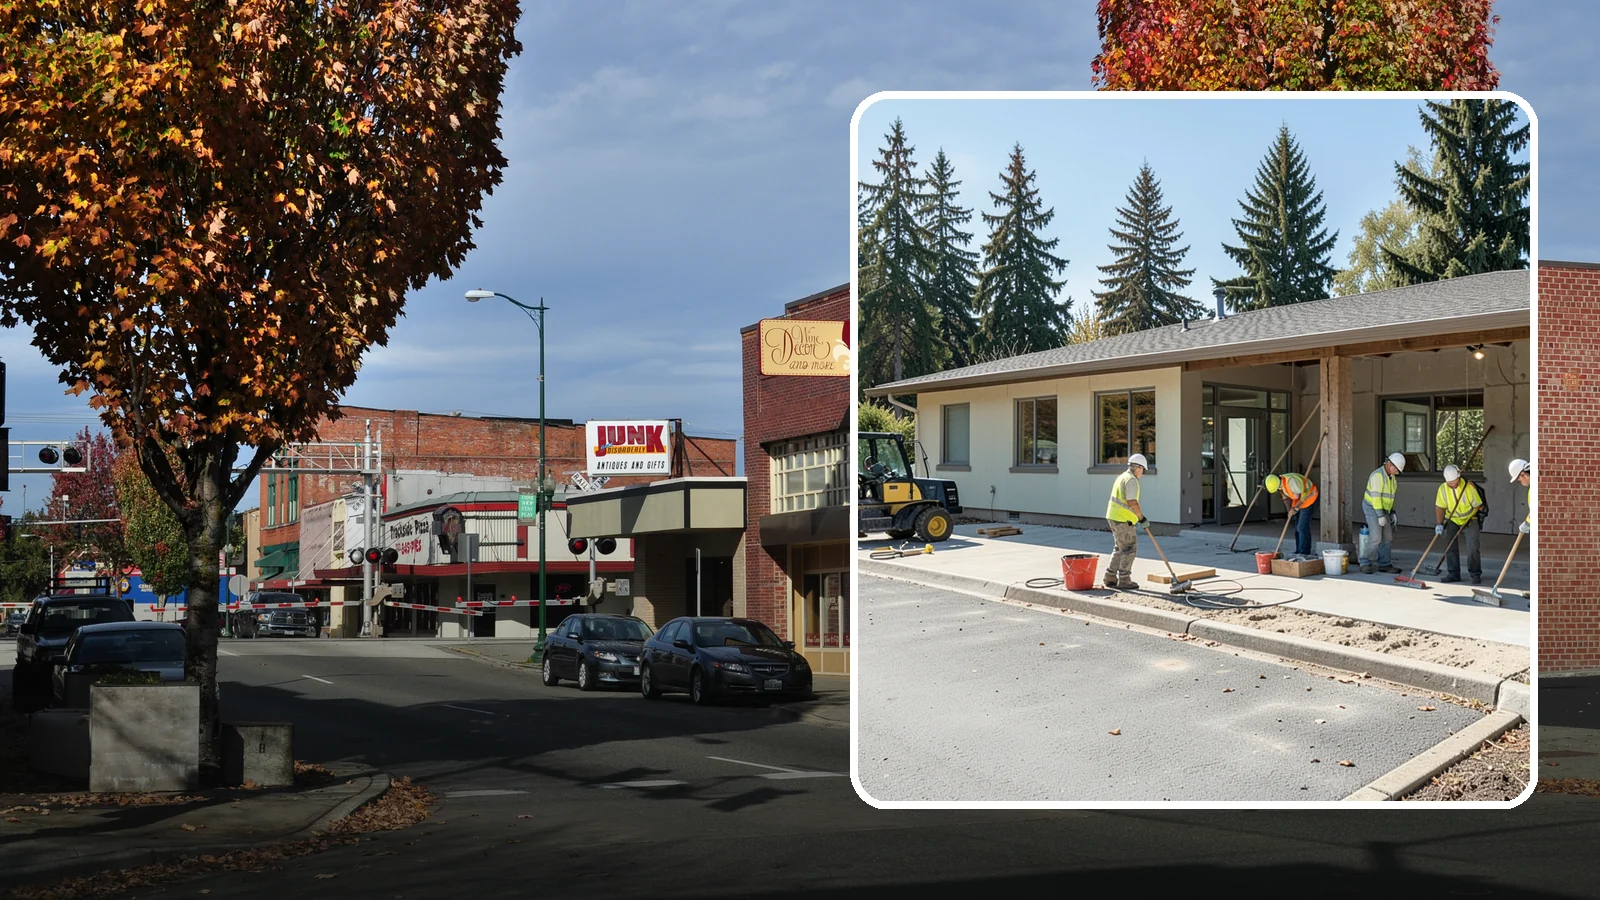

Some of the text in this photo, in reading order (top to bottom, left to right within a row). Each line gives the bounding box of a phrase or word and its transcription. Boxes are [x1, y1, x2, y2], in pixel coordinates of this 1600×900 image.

[595, 425, 666, 458] JUNK
[607, 446, 646, 454] DISORDERLY
[597, 460, 666, 470] ANTIQUES AND GIFTS
[390, 519, 429, 540] Trackside Pizza
